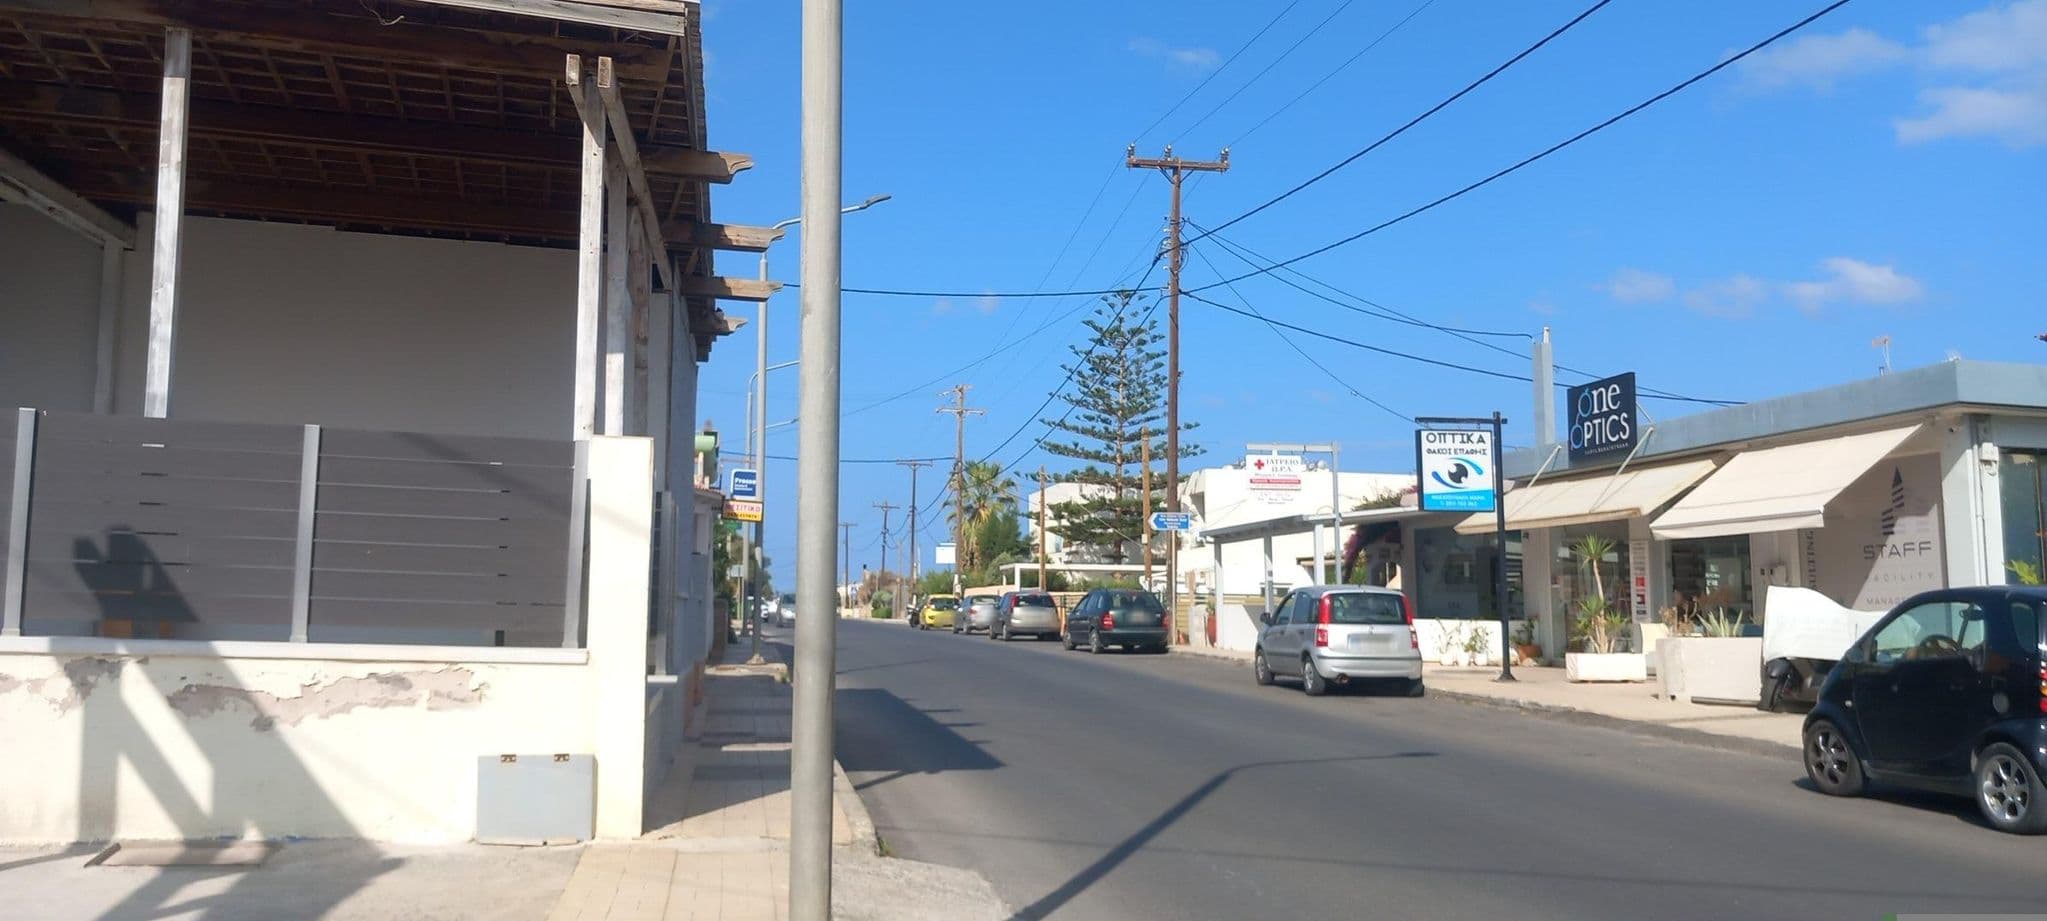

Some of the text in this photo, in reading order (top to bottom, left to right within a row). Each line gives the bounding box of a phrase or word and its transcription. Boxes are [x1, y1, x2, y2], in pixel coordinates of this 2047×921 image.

[1426, 432, 1486, 444] ΟΠΤΙΚΑ
[1571, 412, 1630, 449] OPTICS
[1863, 541, 1932, 560] STAFF
